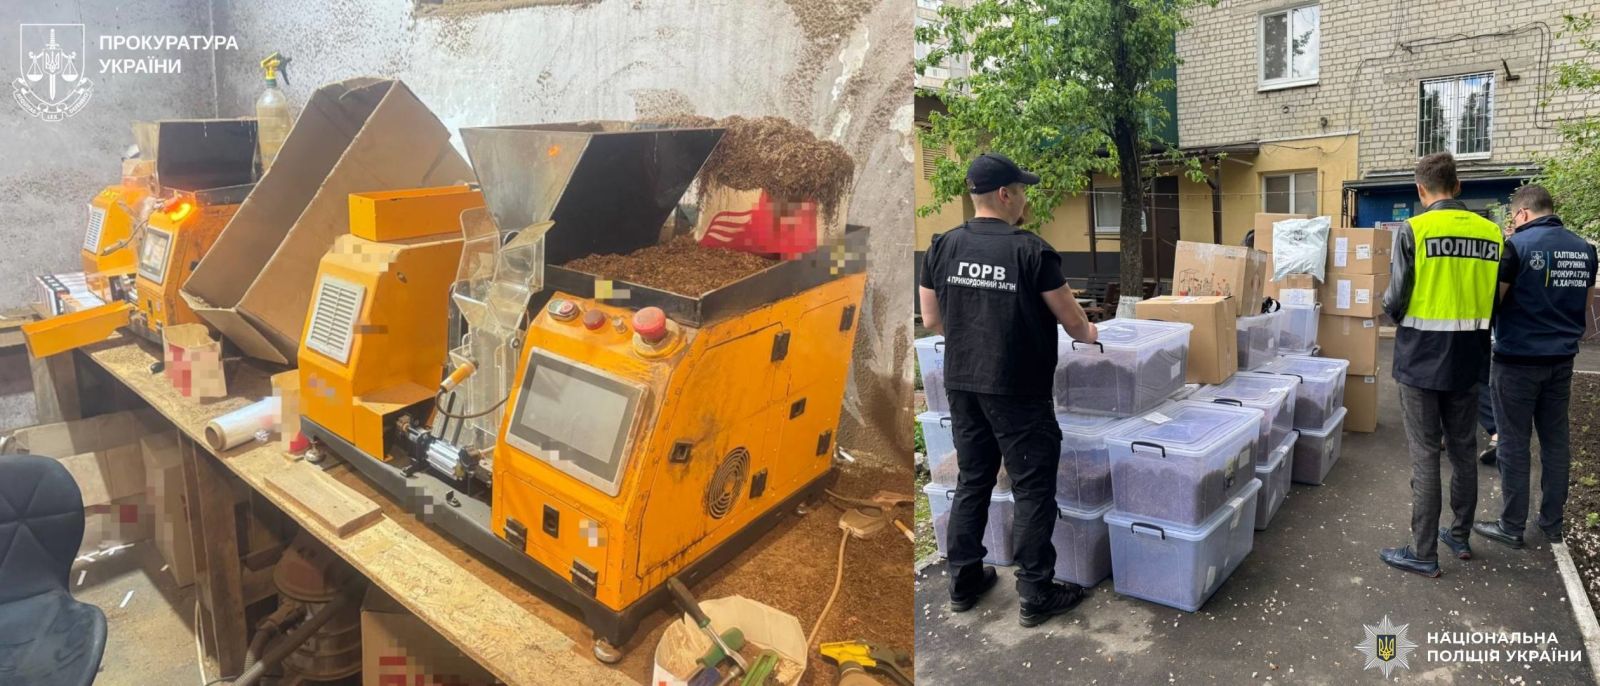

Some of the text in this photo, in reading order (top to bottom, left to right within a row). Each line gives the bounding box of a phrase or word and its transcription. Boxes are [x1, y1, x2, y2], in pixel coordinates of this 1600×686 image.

[1426, 238, 1499, 260] ПОЛІЦІЯ
[1553, 250, 1589, 260] САЛТІВСЬКА
[957, 262, 1006, 280] ГОРВ
[1550, 269, 1590, 279] ПРОКУРАТУРА
[951, 276, 997, 288] ПРИКОРДОННИЙ
[998, 282, 1016, 290] ЗАГІН
